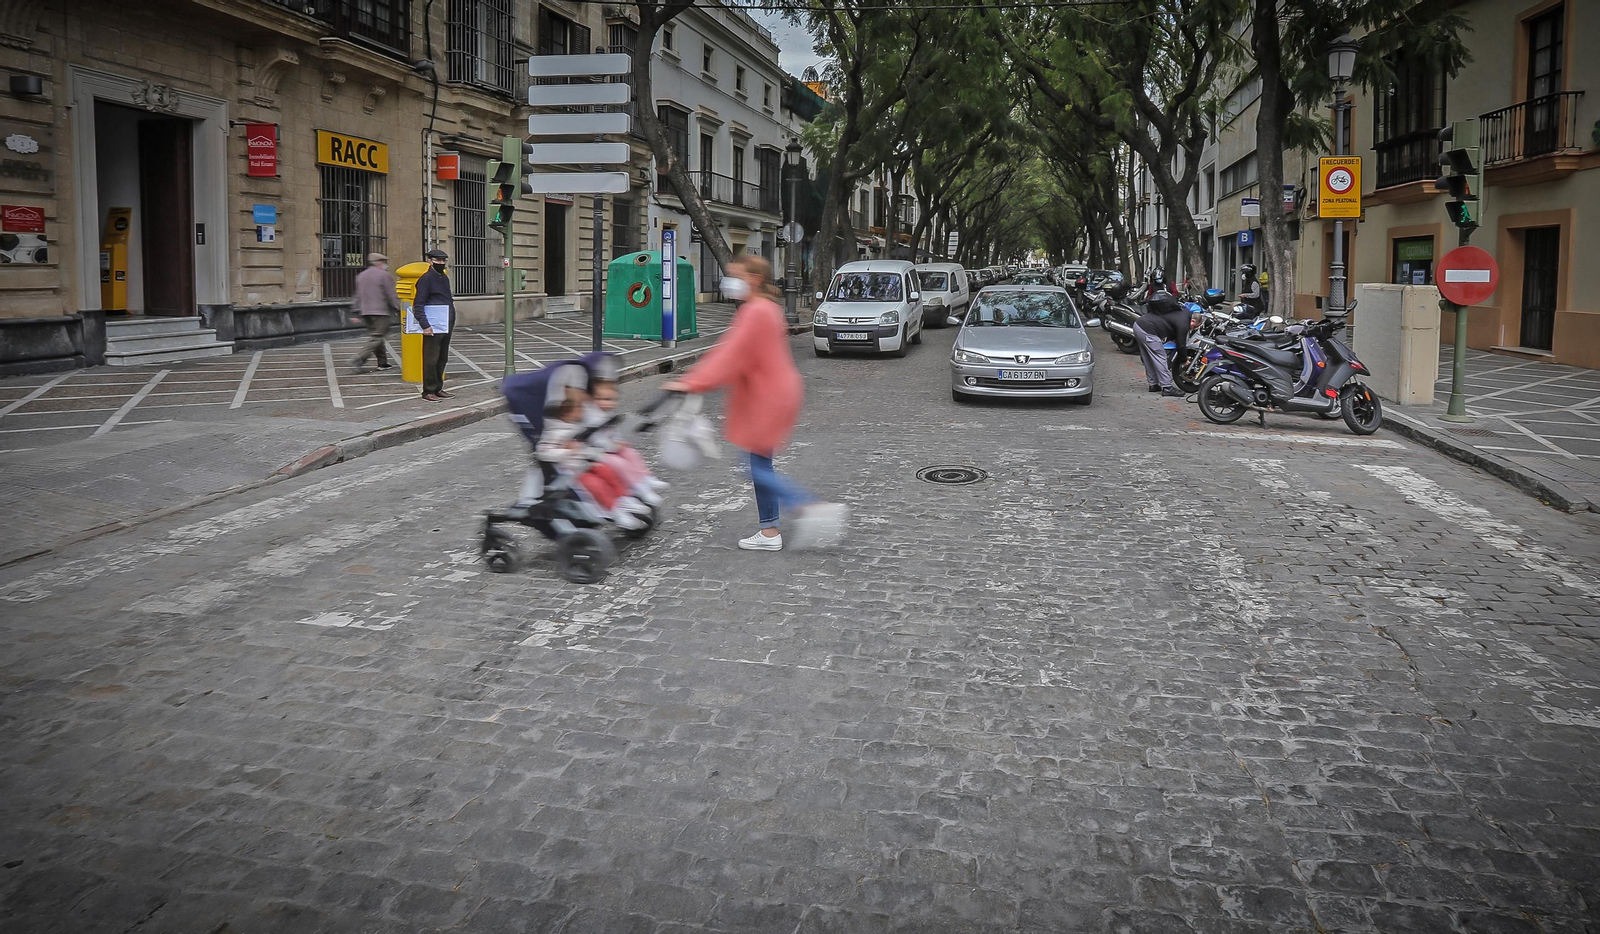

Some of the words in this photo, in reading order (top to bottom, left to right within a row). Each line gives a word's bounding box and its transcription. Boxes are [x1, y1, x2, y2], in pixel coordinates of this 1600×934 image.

[331, 137, 378, 168] RACC
[1241, 233, 1248, 242] B
[1002, 371, 1012, 379] CA
[1013, 371, 1033, 379] 6137
[1034, 371, 1044, 379] BN
